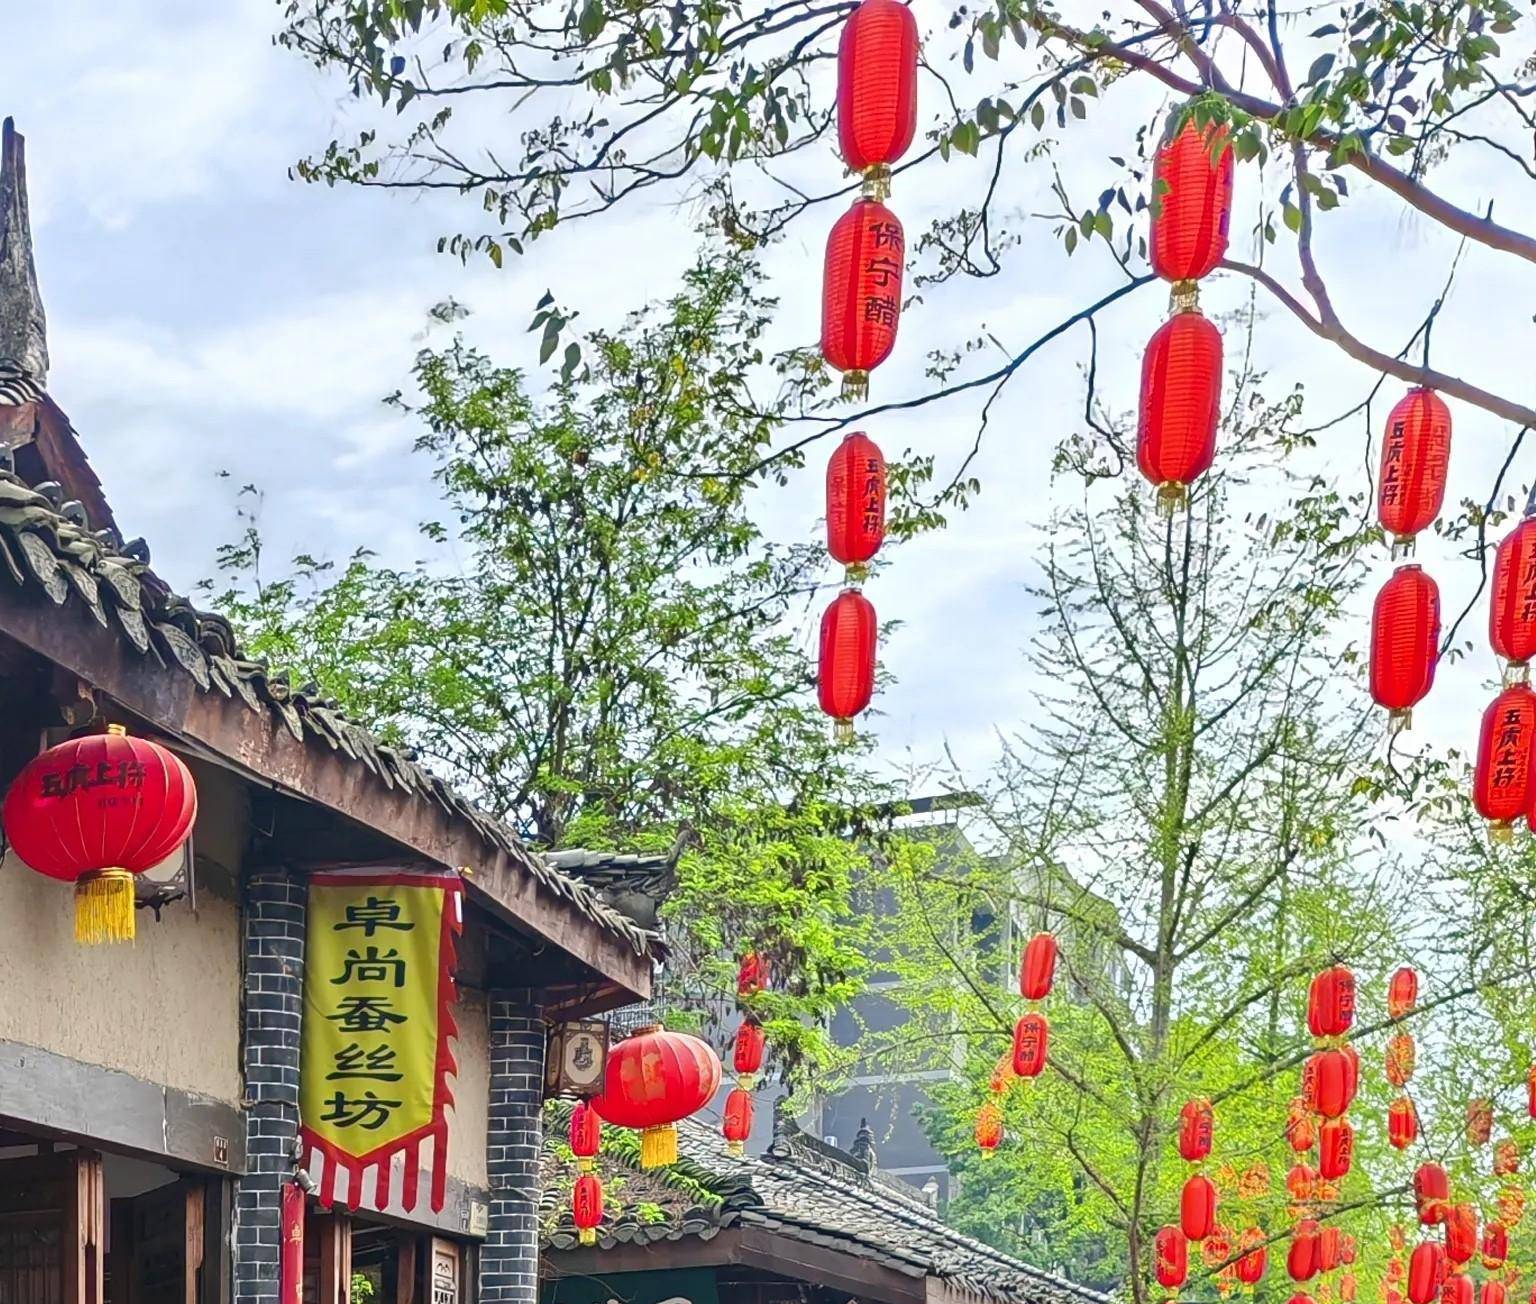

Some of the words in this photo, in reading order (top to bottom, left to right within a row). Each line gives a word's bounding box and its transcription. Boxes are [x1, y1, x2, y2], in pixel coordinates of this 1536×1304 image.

[864, 221, 904, 328] 保宁醋
[321, 897, 415, 1130] 卓尚蚕丝坊
